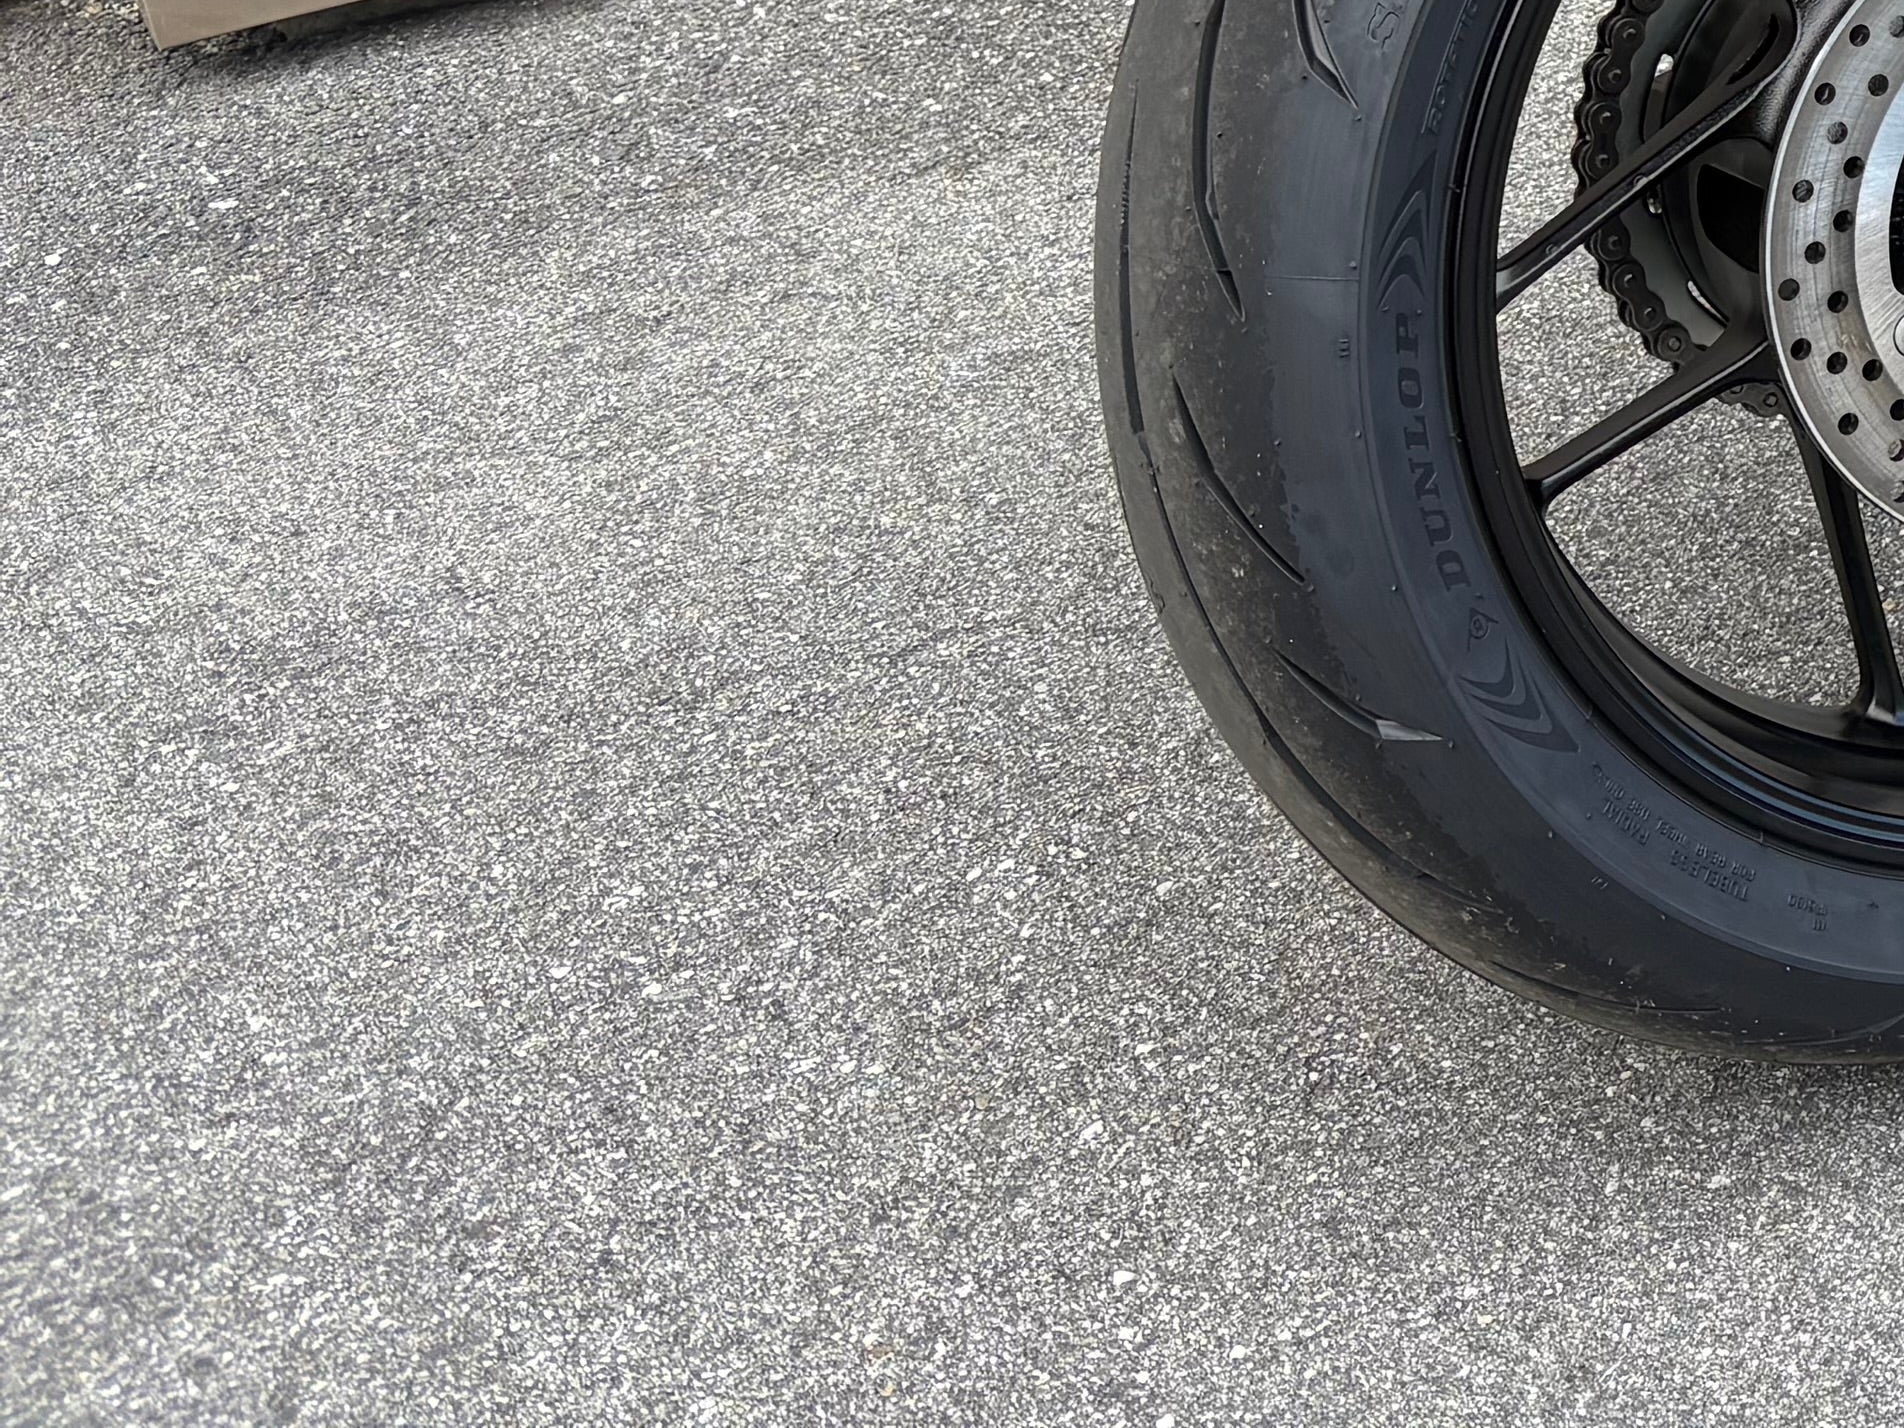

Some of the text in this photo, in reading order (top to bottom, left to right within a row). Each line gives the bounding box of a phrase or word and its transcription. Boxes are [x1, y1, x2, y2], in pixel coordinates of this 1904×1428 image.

[1395, 312, 1472, 593] DUNLOP
[1601, 796, 1751, 902] TUBELESS RADIAL
